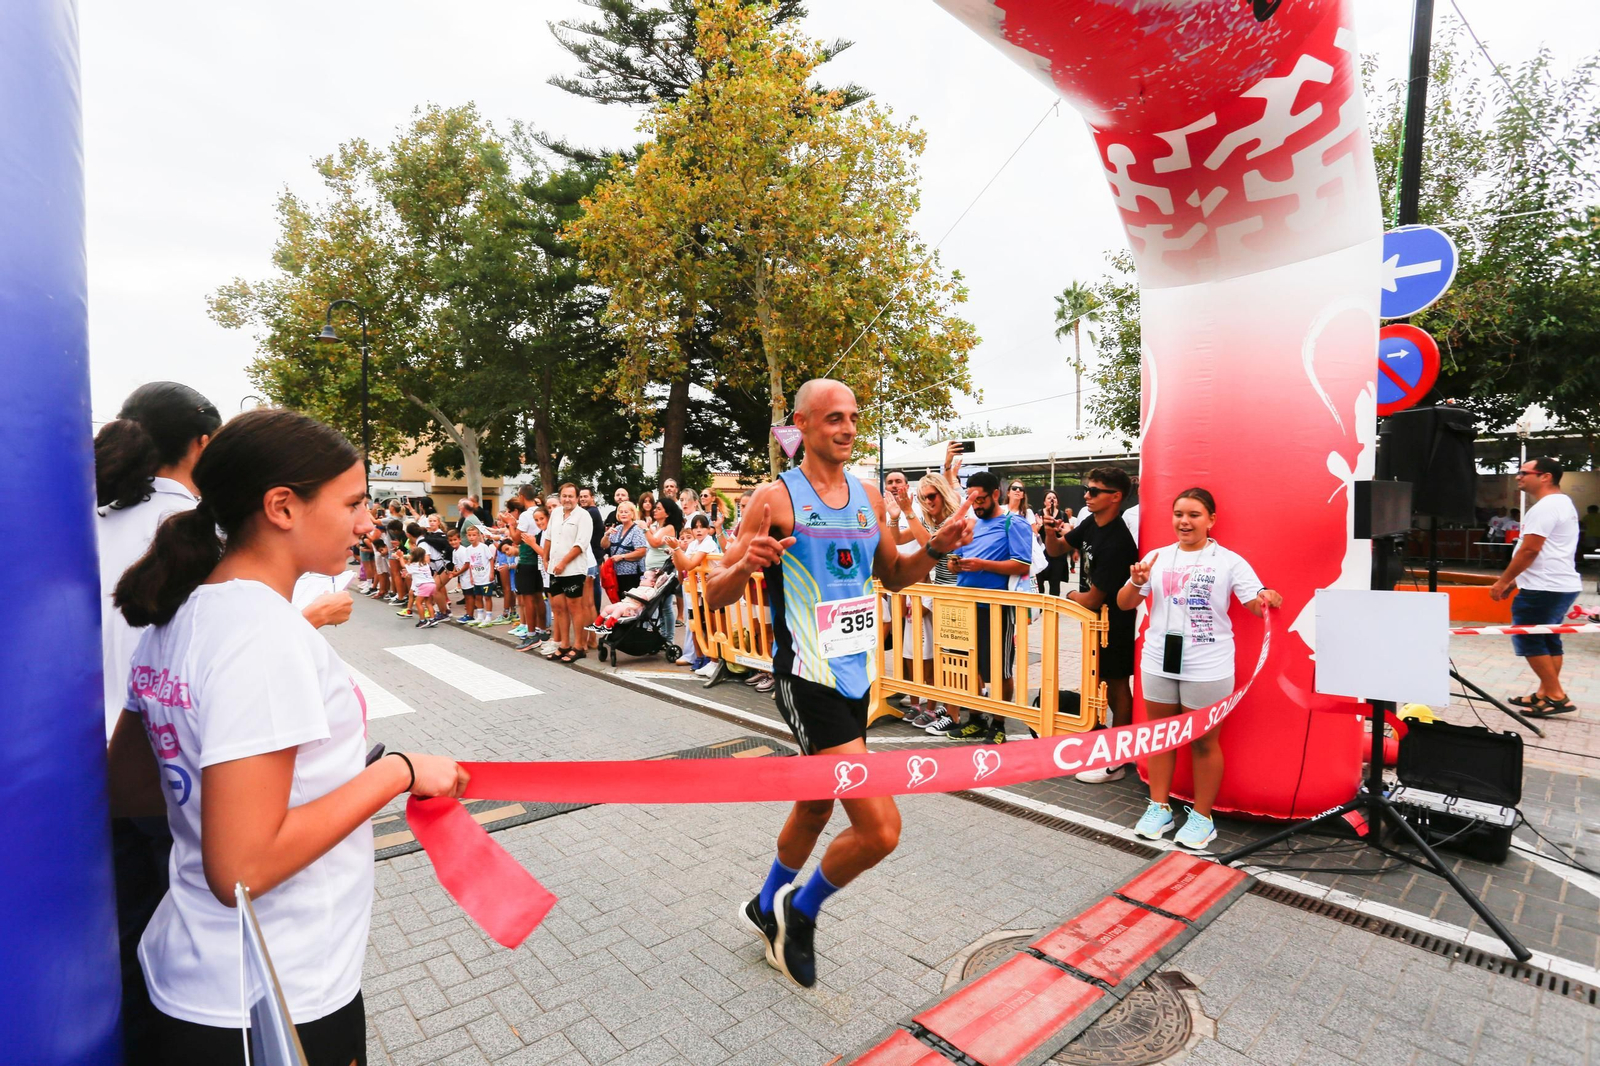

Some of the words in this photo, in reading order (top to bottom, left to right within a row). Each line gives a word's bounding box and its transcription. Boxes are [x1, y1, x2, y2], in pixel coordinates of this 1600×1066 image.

[840, 611, 874, 634] 395
[950, 634, 970, 642] Barrios
[1053, 716, 1194, 770] CARRERA
